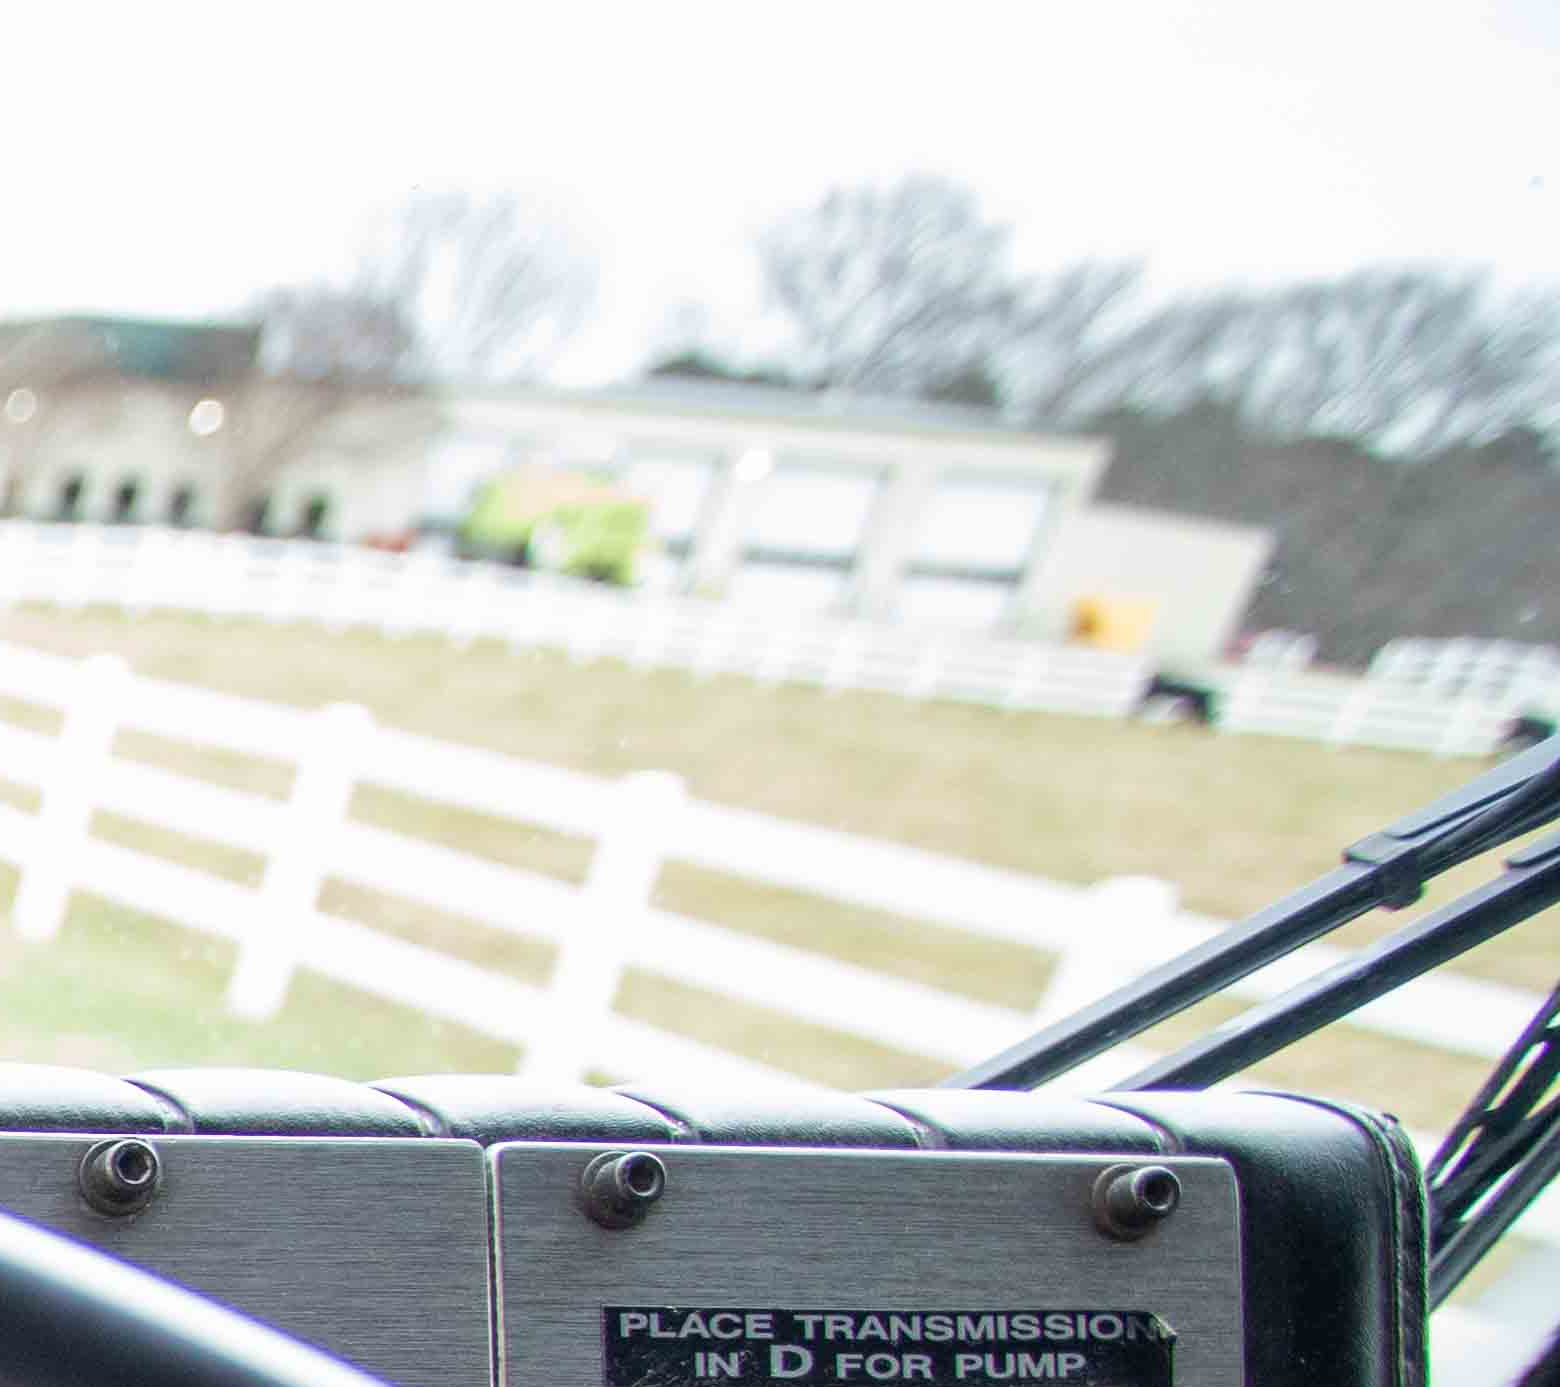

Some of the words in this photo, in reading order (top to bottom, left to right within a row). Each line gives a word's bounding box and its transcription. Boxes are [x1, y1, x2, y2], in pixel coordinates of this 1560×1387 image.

[620, 1312, 773, 1341] PLACE
[694, 1352, 740, 1379] IN
[770, 1345, 813, 1379] D
[836, 1353, 931, 1379] FOR
[955, 1353, 1087, 1379] PUMP
